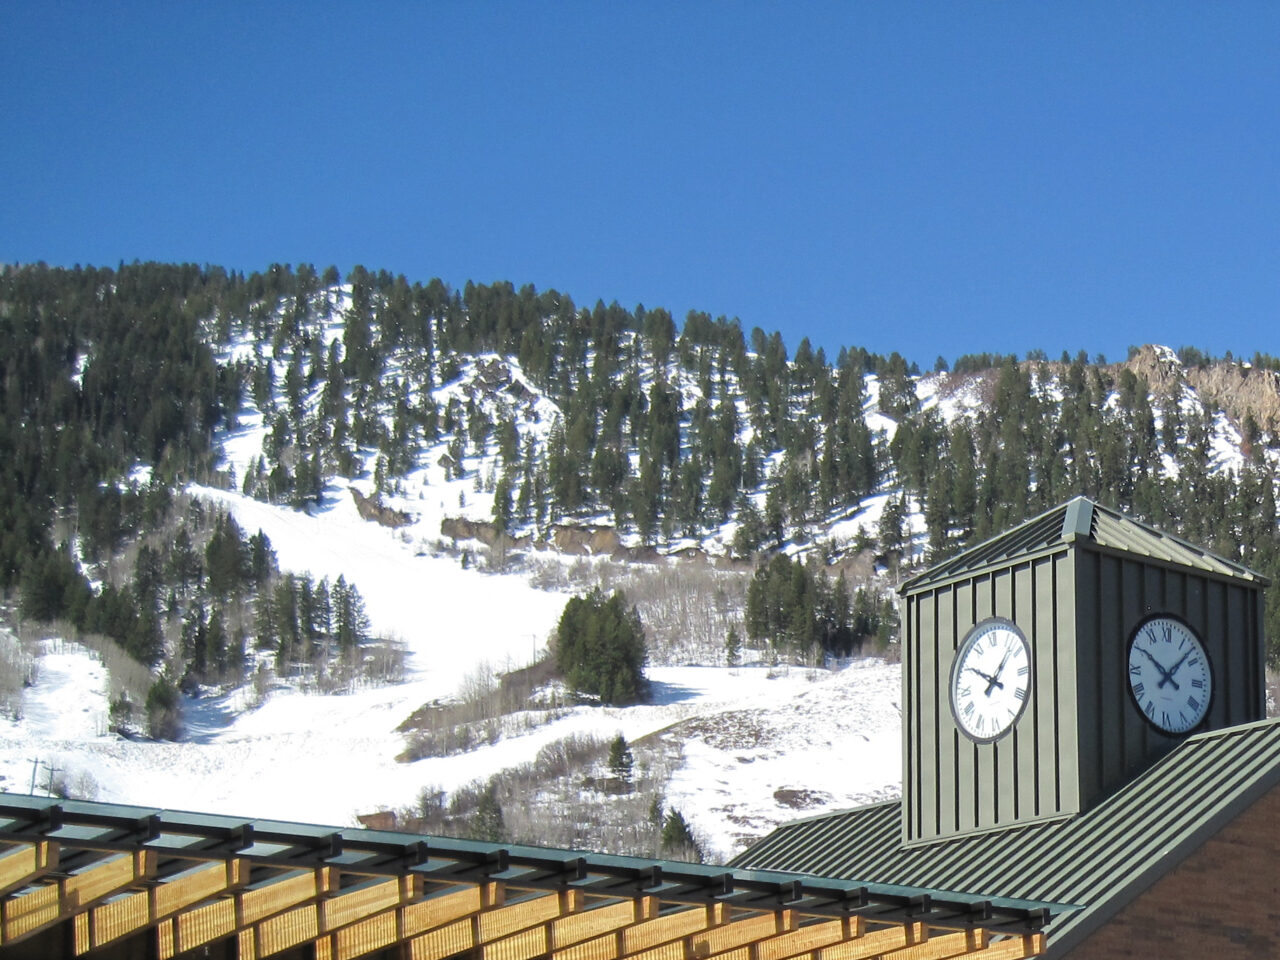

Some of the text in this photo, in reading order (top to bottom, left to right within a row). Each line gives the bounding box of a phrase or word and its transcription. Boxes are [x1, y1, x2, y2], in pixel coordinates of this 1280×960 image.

[1146, 628, 1157, 645] XI
[1162, 626, 1172, 643] XII
[1188, 657, 1198, 667] II
[1018, 666, 1028, 676] III
[1130, 664, 1141, 675] IX
[1192, 679, 1203, 688] III
[992, 717, 1000, 731] VI
[1162, 711, 1171, 727] VI
